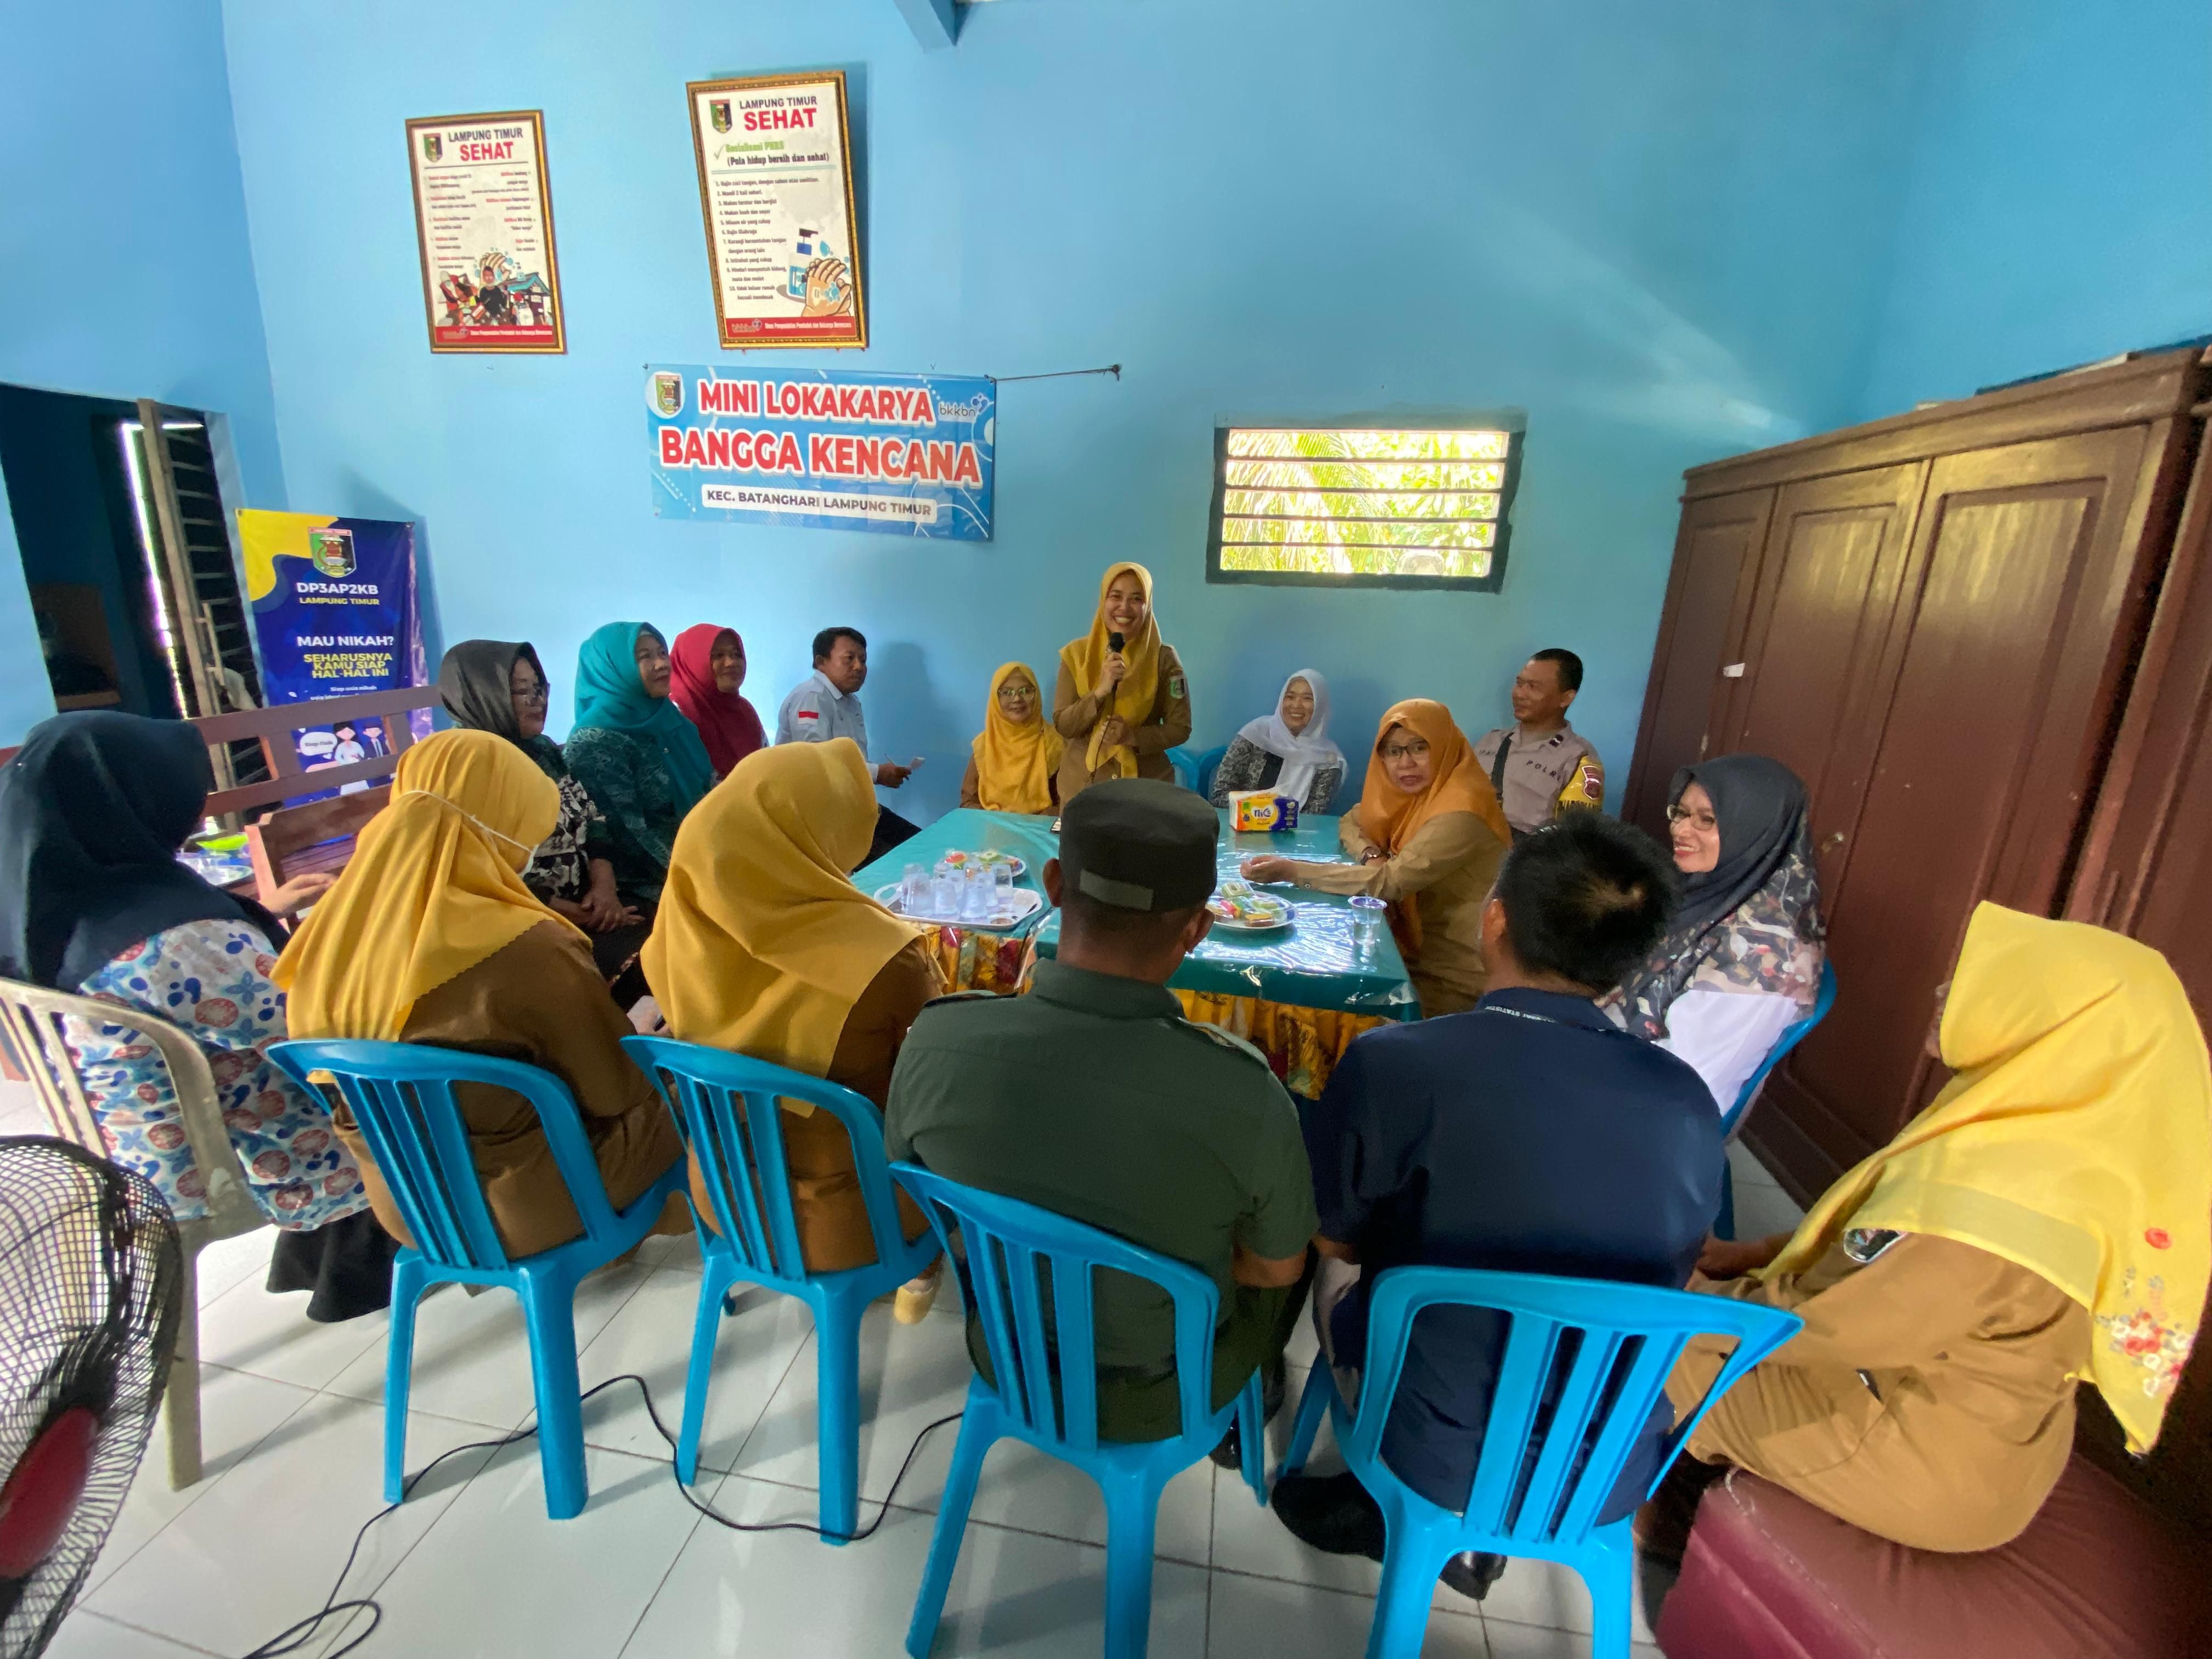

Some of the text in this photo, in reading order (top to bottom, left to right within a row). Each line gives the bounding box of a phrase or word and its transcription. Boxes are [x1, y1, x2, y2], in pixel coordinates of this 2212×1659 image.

[739, 95, 817, 109] LAMPUNG TIMUR
[743, 108, 817, 131] SEHAT
[448, 127, 523, 143] LAMPUNG TIMUR
[459, 141, 514, 162] SEHAT
[727, 152, 830, 167] (Pola hidup bersih dan sehat)
[699, 381, 934, 424] MINI LOKAKARYA
[939, 403, 976, 417] bkkbn
[660, 428, 981, 486] BANGGA KENCANA
[707, 490, 932, 516] KEC. BATANGHARI LAMPUNG TIMUR
[296, 582, 379, 595] DP3AP2KB
[297, 636, 394, 647] MAU NIKAH?
[303, 653, 393, 663] SEHARUSNYA
[313, 661, 386, 670] KAMU SIAP
[312, 668, 389, 679] HAL-HAL INI
[1526, 760, 1561, 781] POLRI
